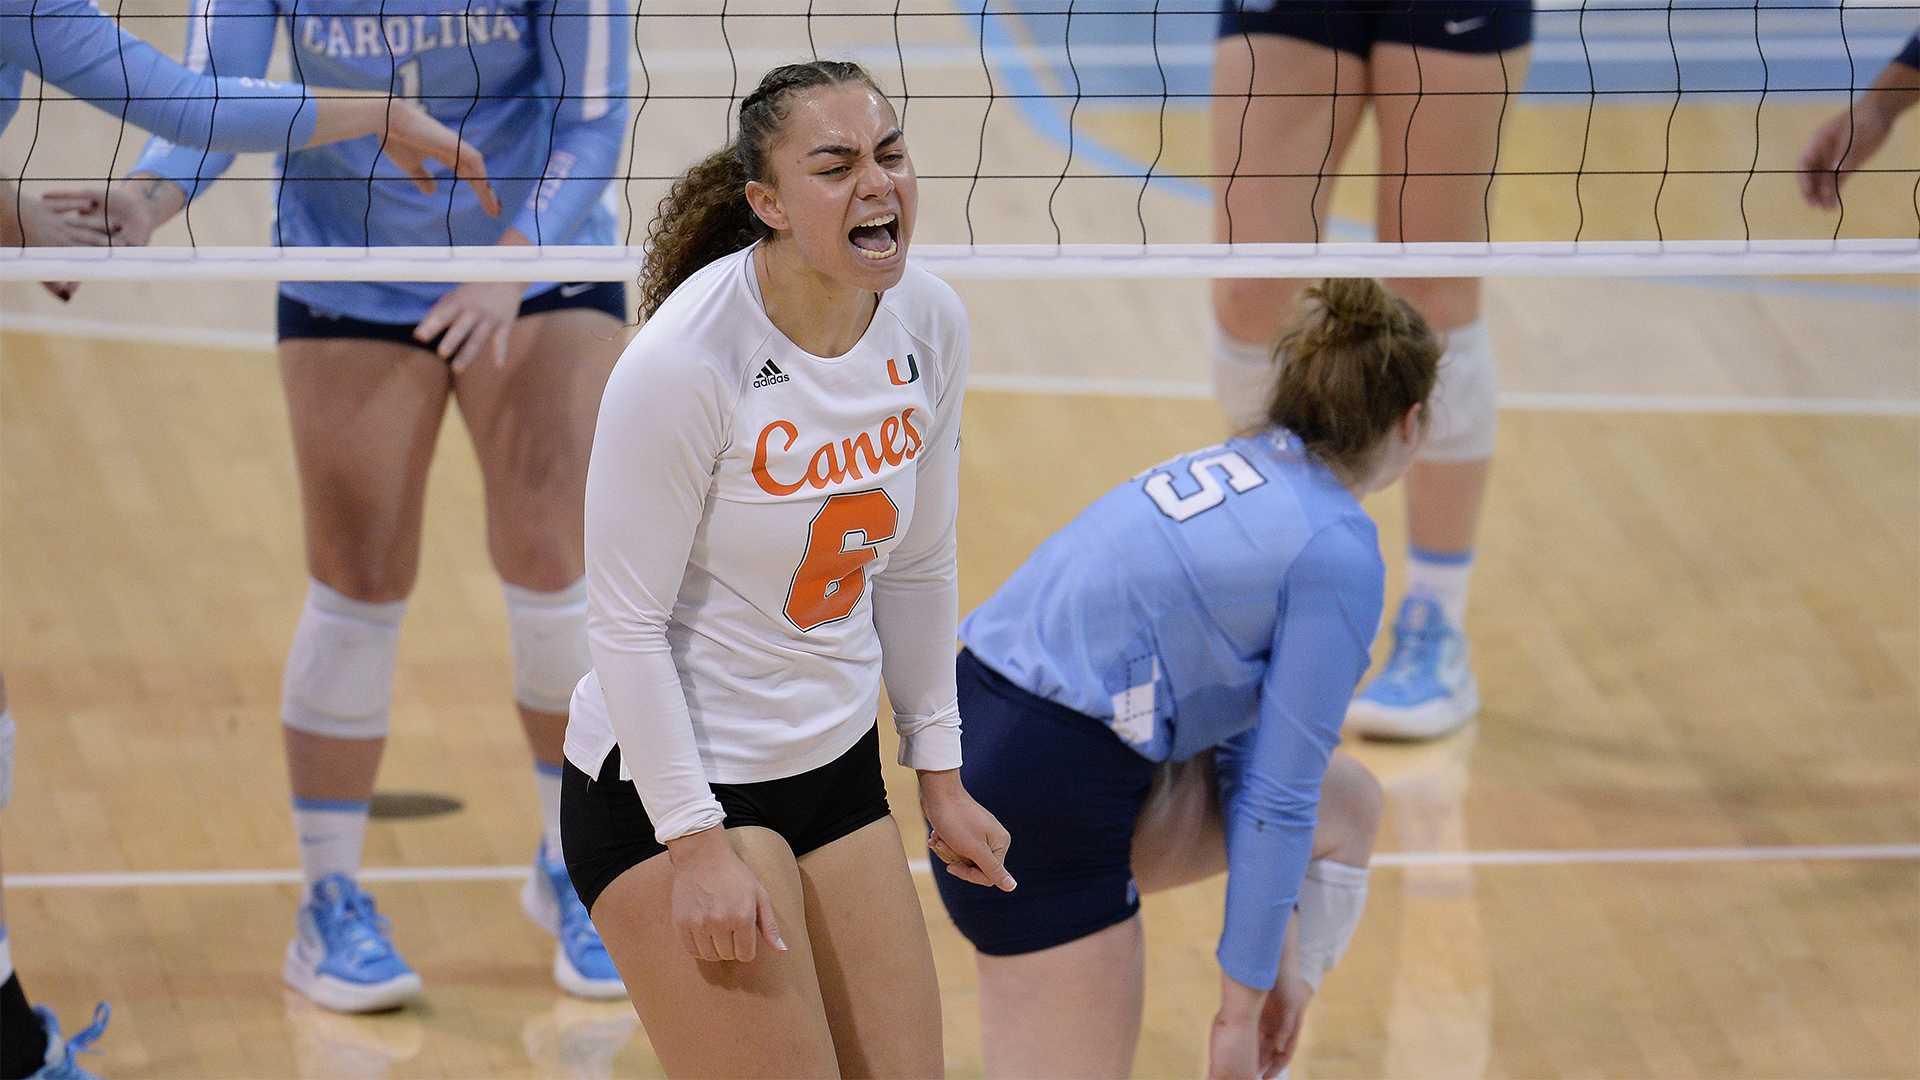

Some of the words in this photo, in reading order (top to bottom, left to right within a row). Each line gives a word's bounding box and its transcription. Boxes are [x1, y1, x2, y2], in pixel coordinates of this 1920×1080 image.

[303, 7, 520, 58] CAROLINA
[398, 58, 429, 115] 1
[753, 374, 790, 389] adidas
[887, 353, 919, 386] U
[751, 407, 922, 496] Canes
[1130, 443, 1268, 523] 5
[782, 487, 899, 633] 6
